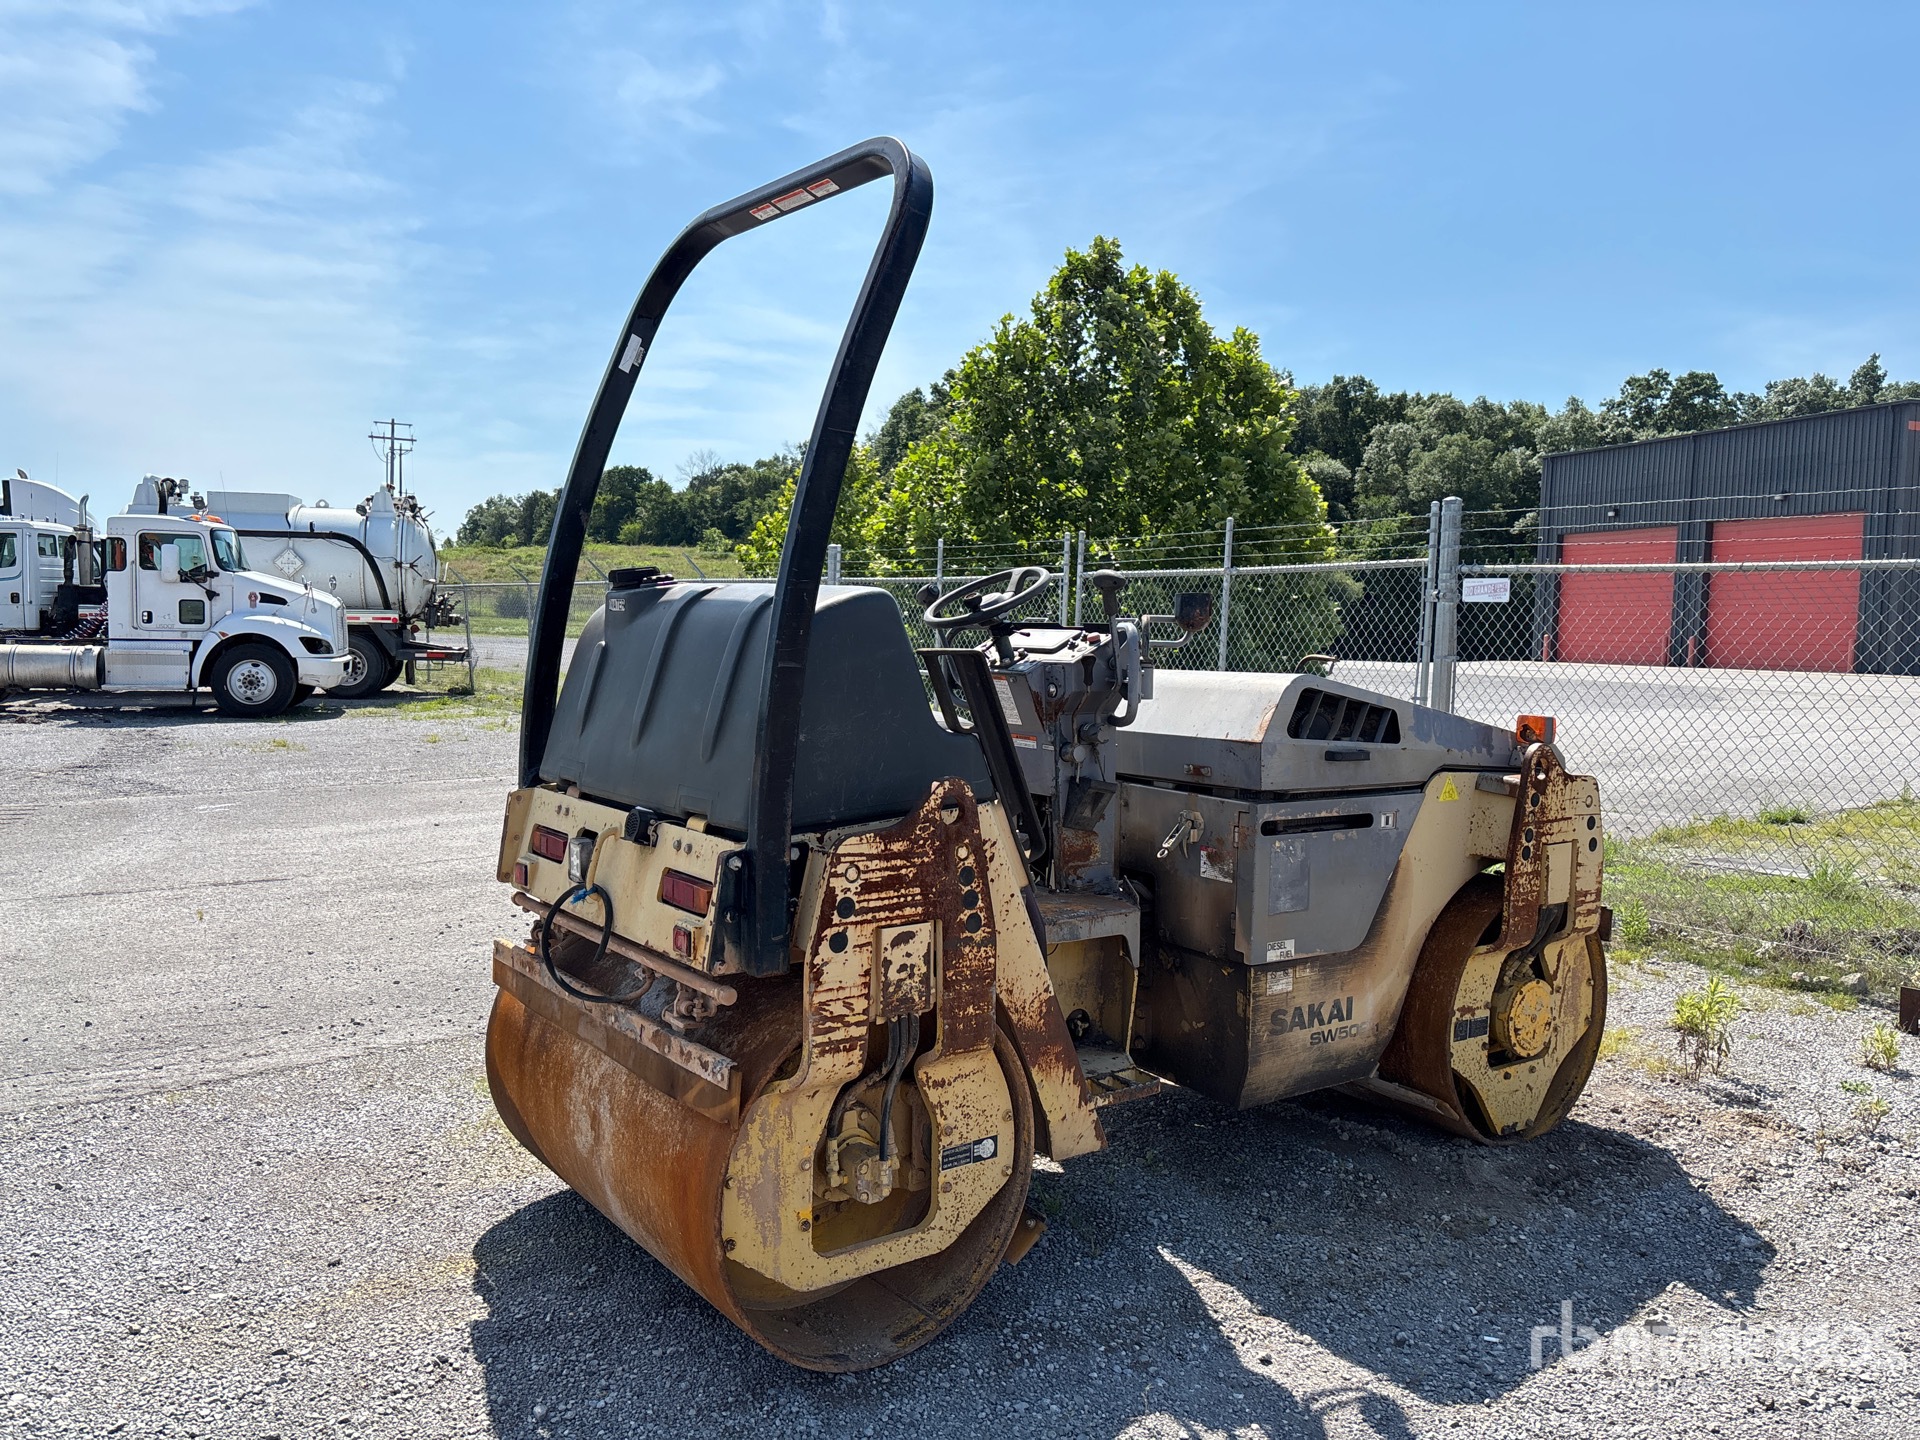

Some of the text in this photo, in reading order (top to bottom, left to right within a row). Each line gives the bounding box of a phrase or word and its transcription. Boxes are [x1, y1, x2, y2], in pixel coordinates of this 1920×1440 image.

[1267, 941, 1286, 951] DIESEL
[1280, 950, 1294, 960] FUEL
[1268, 996, 1354, 1036] SAKAI
